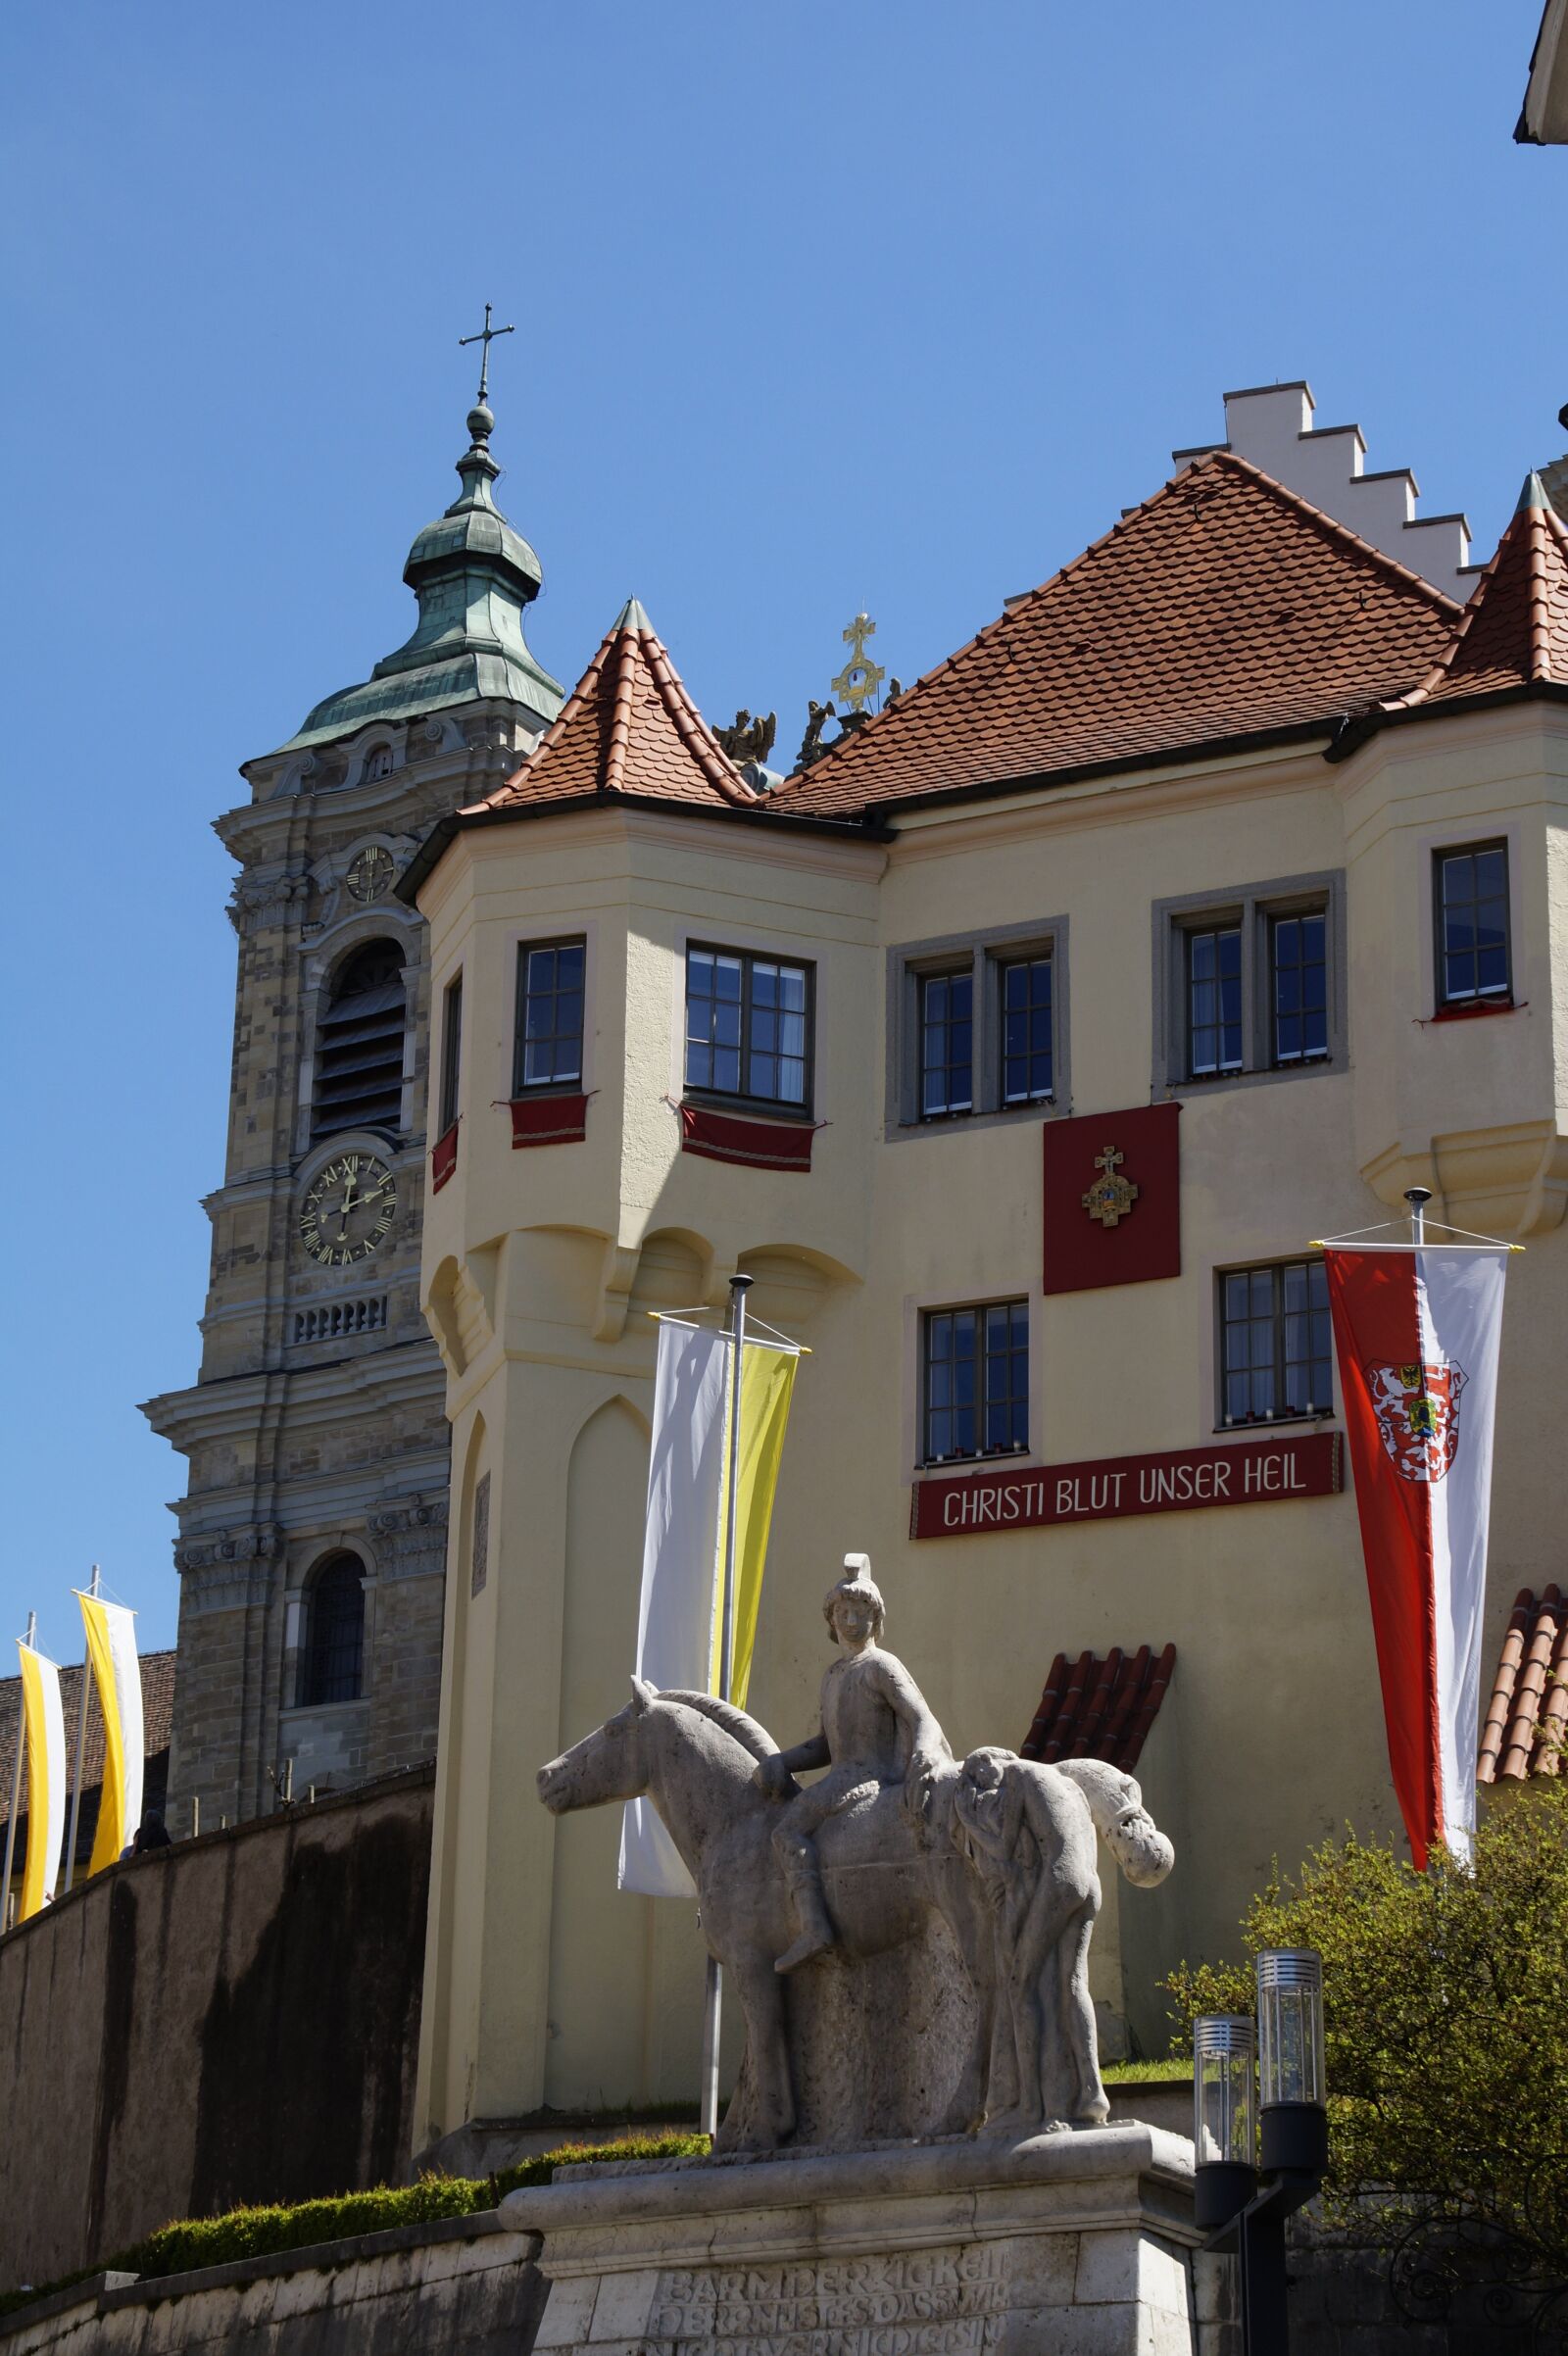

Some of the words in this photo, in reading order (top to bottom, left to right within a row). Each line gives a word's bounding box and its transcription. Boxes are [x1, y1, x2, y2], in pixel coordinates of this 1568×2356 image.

[342, 1155, 359, 1175] XII
[321, 1166, 338, 1187] XI
[377, 1171, 393, 1186] II
[308, 1190, 322, 1203] X
[383, 1194, 396, 1206] III
[364, 1240, 375, 1254] V
[944, 1482, 1044, 1527] CHRISTI
[1055, 1473, 1128, 1514] BLUT
[1140, 1461, 1231, 1503] UNSER
[1245, 1452, 1306, 1494] HEIL
